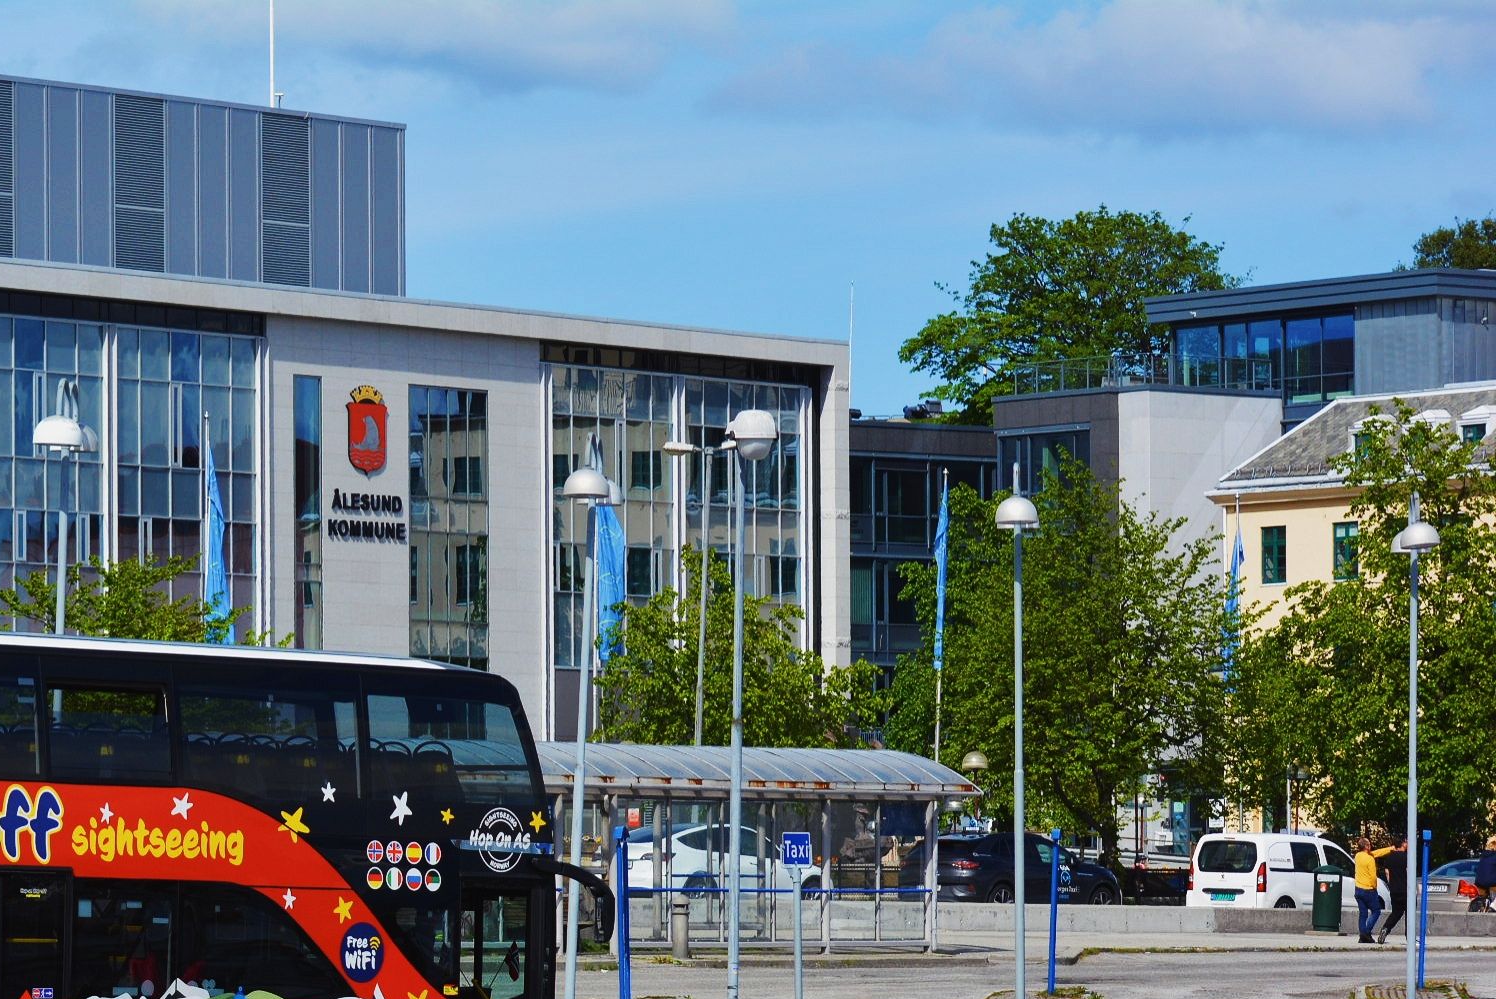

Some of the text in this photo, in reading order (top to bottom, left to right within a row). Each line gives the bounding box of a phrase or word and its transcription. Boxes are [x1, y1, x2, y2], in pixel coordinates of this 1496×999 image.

[332, 488, 403, 513] ÅLESUND
[328, 519, 406, 541] KOMMUNE
[484, 811, 518, 828] SIGHTSEEING
[71, 816, 245, 866] sightseeing
[469, 829, 531, 851] Hop On AS
[784, 840, 809, 858] Taxi
[347, 936, 368, 948] Free
[345, 950, 377, 970] WiFi
